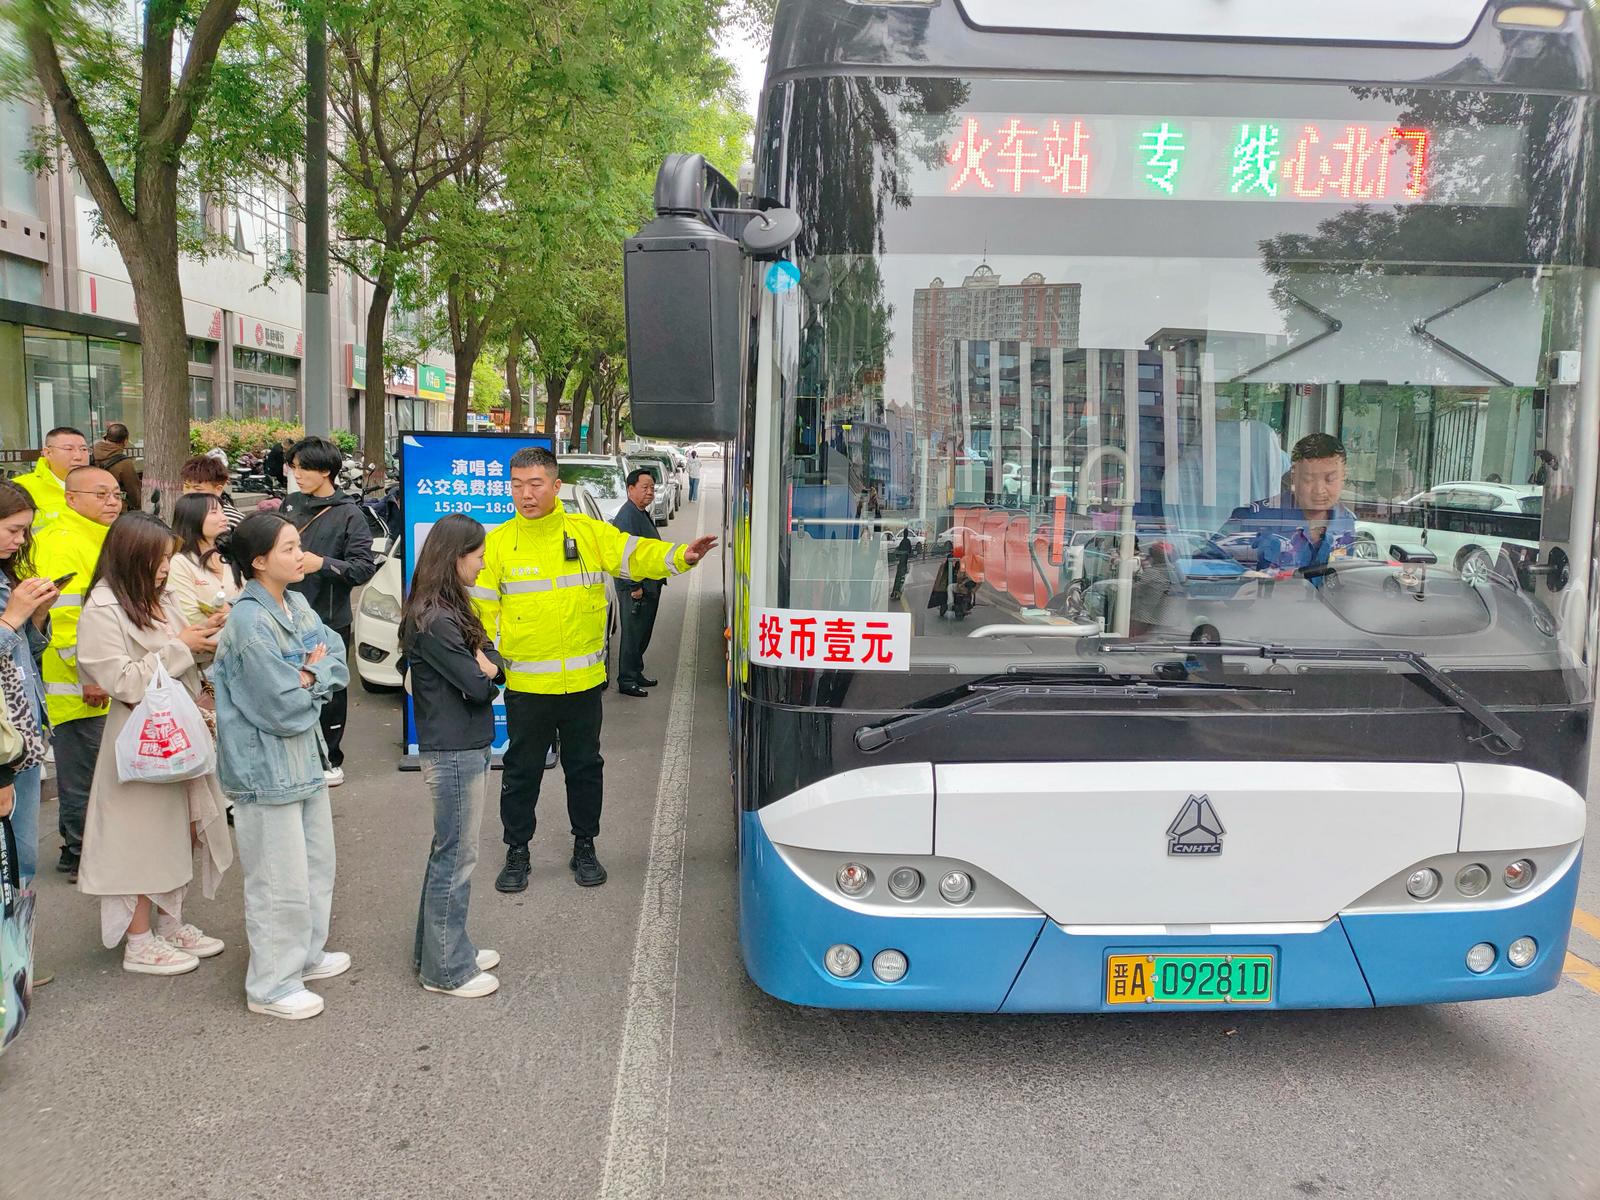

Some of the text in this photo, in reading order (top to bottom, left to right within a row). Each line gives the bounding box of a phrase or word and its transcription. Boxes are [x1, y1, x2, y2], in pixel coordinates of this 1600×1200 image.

[951, 118, 1090, 193] 火车站
[1138, 122, 1186, 195] 专
[451, 459, 504, 477] 演唱会
[758, 613, 894, 664] 投币壹元
[1173, 844, 1220, 853] CNHTC
